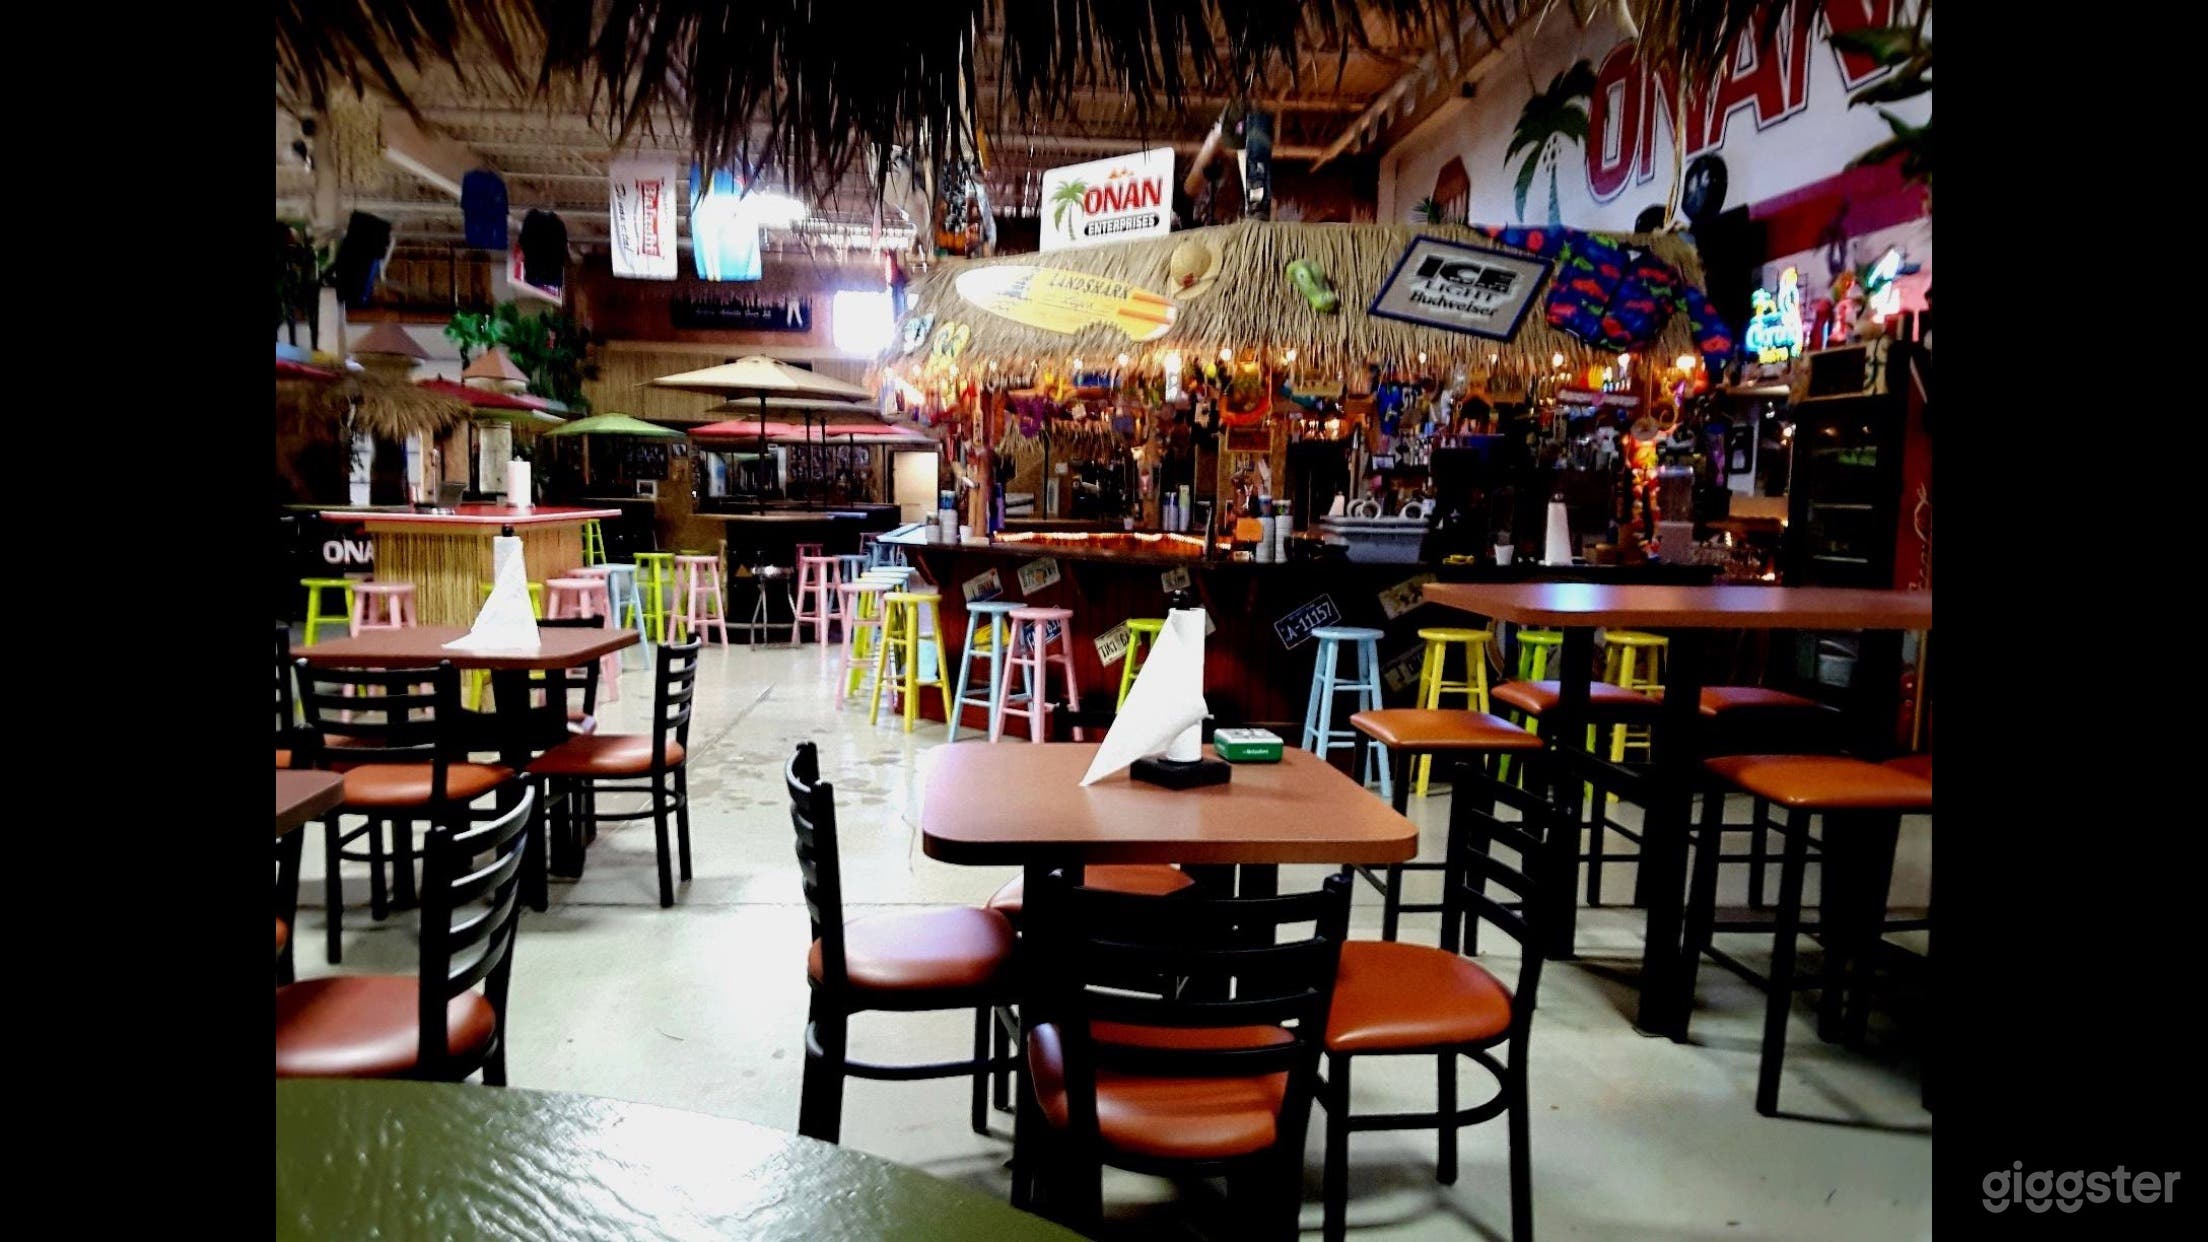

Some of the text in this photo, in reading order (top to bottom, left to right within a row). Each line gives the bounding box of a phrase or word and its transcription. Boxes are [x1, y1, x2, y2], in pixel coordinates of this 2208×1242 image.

[1083, 178, 1162, 214] ONAN
[1087, 215, 1156, 236] ENTERPRISES
[1048, 273, 1132, 300] LANDSHARK
[1415, 254, 1518, 296] ICE
[1409, 290, 1499, 317] Budweiser
[1424, 279, 1498, 303] LIGHT
[323, 540, 375, 565] ONA
